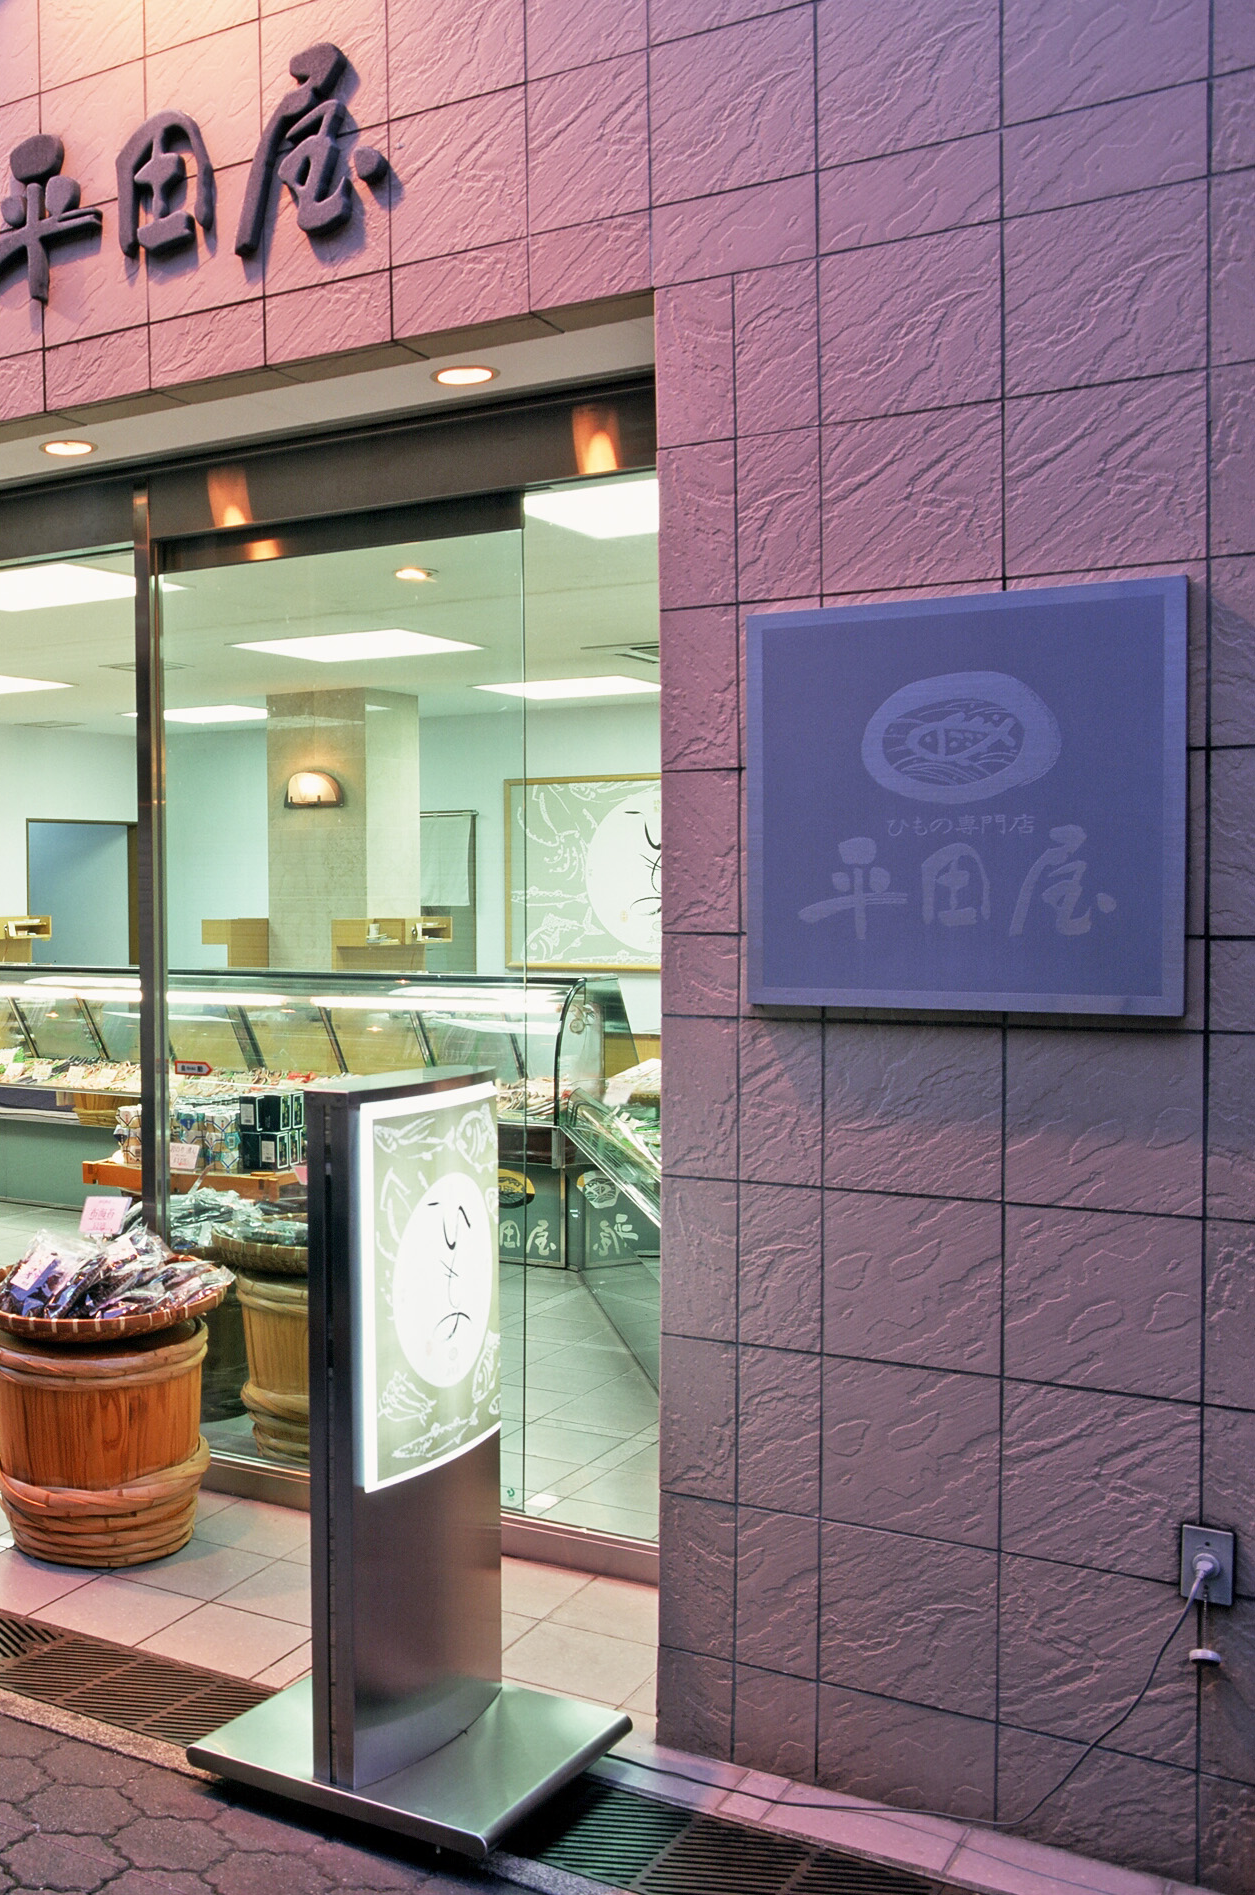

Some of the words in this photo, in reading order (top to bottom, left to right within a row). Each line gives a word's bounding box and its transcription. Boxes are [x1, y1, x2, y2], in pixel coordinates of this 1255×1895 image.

[887, 814, 1036, 836] ひもの専門店
[798, 825, 1117, 940] 平田屋
